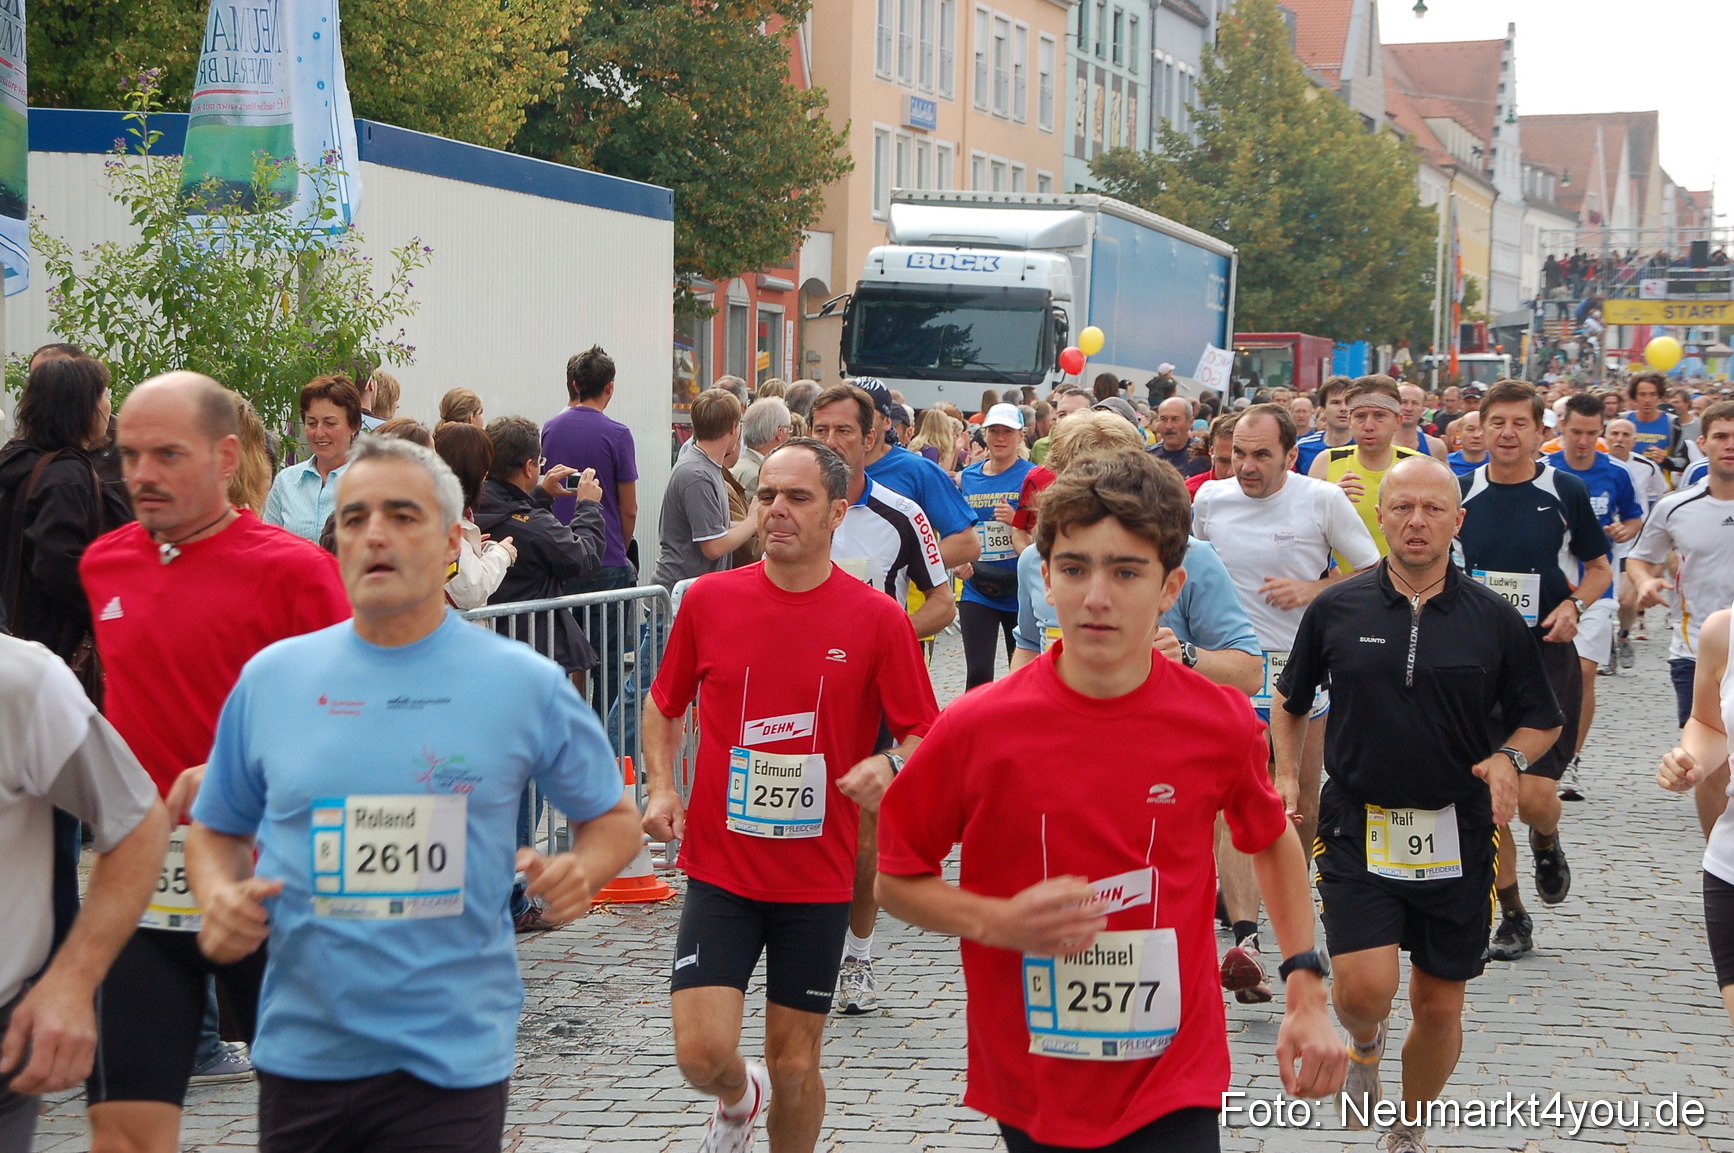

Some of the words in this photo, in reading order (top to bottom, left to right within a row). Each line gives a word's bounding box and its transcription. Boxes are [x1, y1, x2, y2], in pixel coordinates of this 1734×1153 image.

[906, 252, 1001, 272] BOCK
[1663, 304, 1729, 320] START
[986, 525, 1005, 534] Margit
[914, 512, 941, 566] BOSCH
[1489, 576, 1518, 589] Ludwig
[1359, 636, 1386, 644] SUUNTO
[1405, 625, 1419, 687] SALOMON
[762, 721, 795, 736] DEHN
[754, 759, 802, 778] Edmund
[733, 779, 740, 790] C
[753, 784, 815, 808] 2576
[355, 807, 417, 831] Roland
[1391, 811, 1414, 826] Ralf
[1371, 831, 1378, 842] B
[1408, 833, 1435, 855] 91
[356, 842, 448, 875] 2610
[1425, 865, 1461, 874] PFLEIDERER
[1032, 975, 1042, 993] C
[1067, 980, 1161, 1014] 2577
